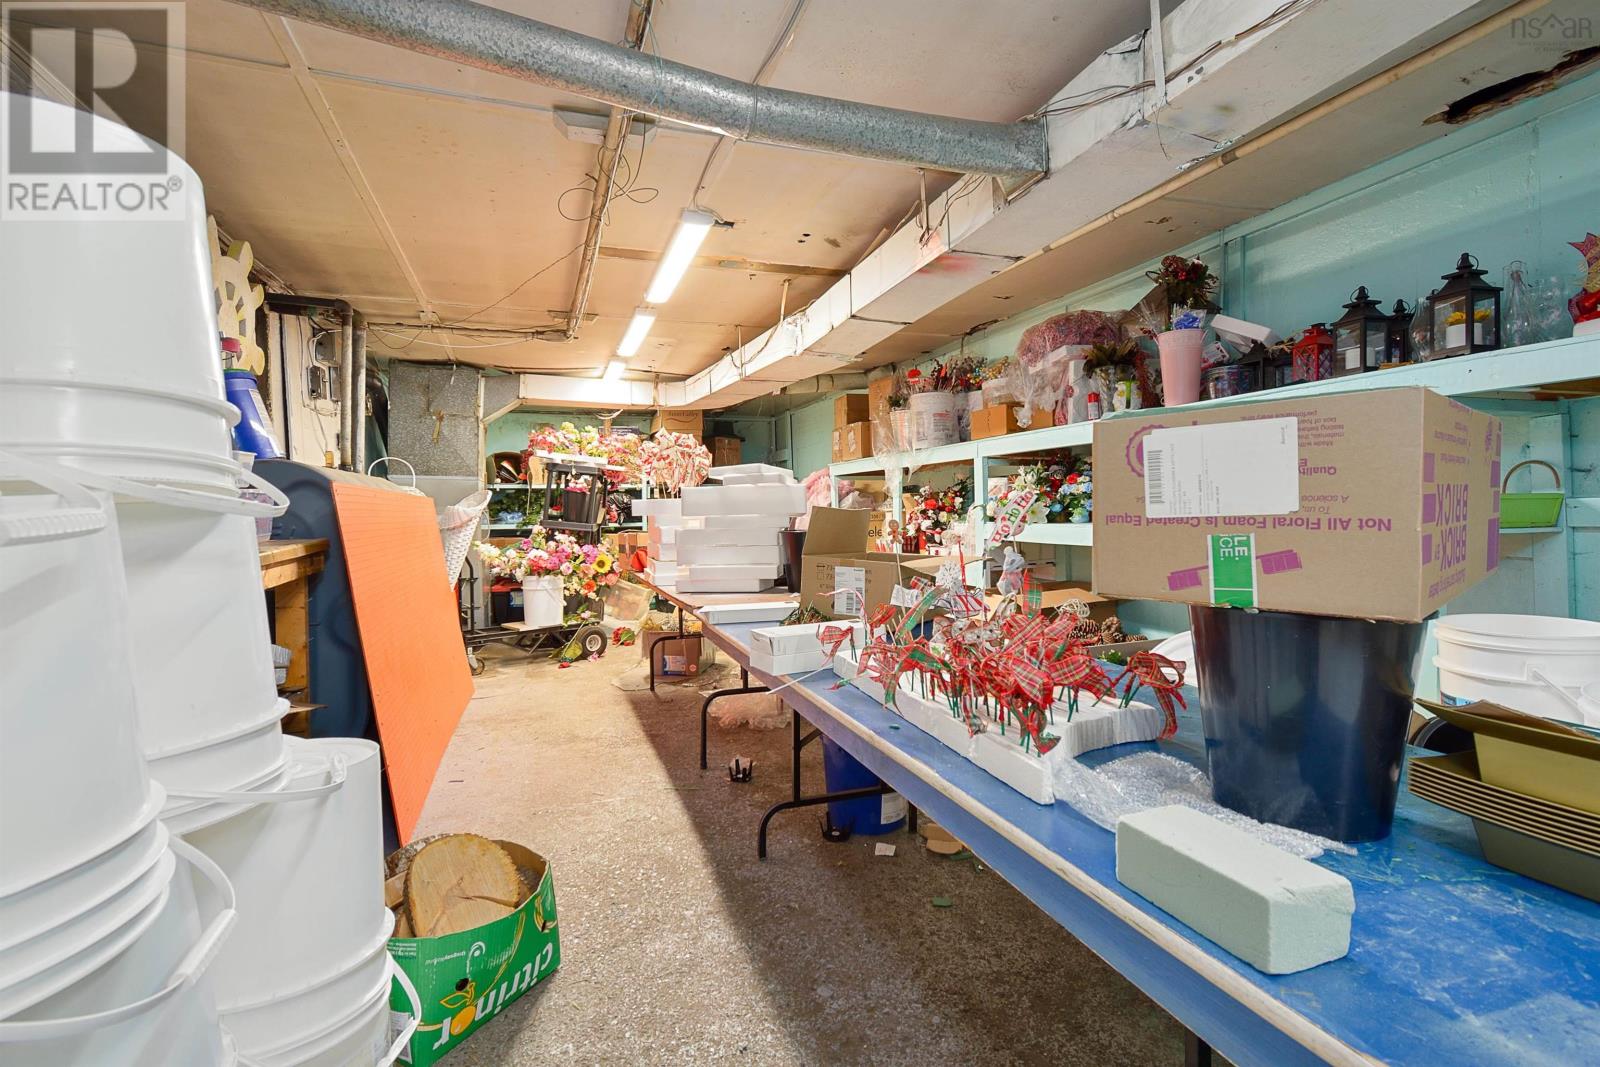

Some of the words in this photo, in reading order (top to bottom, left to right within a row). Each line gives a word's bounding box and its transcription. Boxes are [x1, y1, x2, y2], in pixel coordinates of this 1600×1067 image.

[1298, 466, 1337, 476] Quality
[1012, 490, 1034, 508] Ho
[1341, 495, 1350, 504] A
[1434, 483, 1469, 527] BRICK
[1318, 506, 1330, 514] To
[1105, 513, 1142, 527] Equal
[1146, 516, 1201, 528] Created
[1205, 516, 1218, 528] Is
[1223, 516, 1267, 530] Foam
[1272, 516, 1321, 530] Floral
[1327, 517, 1352, 531] All
[1358, 518, 1392, 532] Not
[1440, 525, 1468, 571] BRICK
